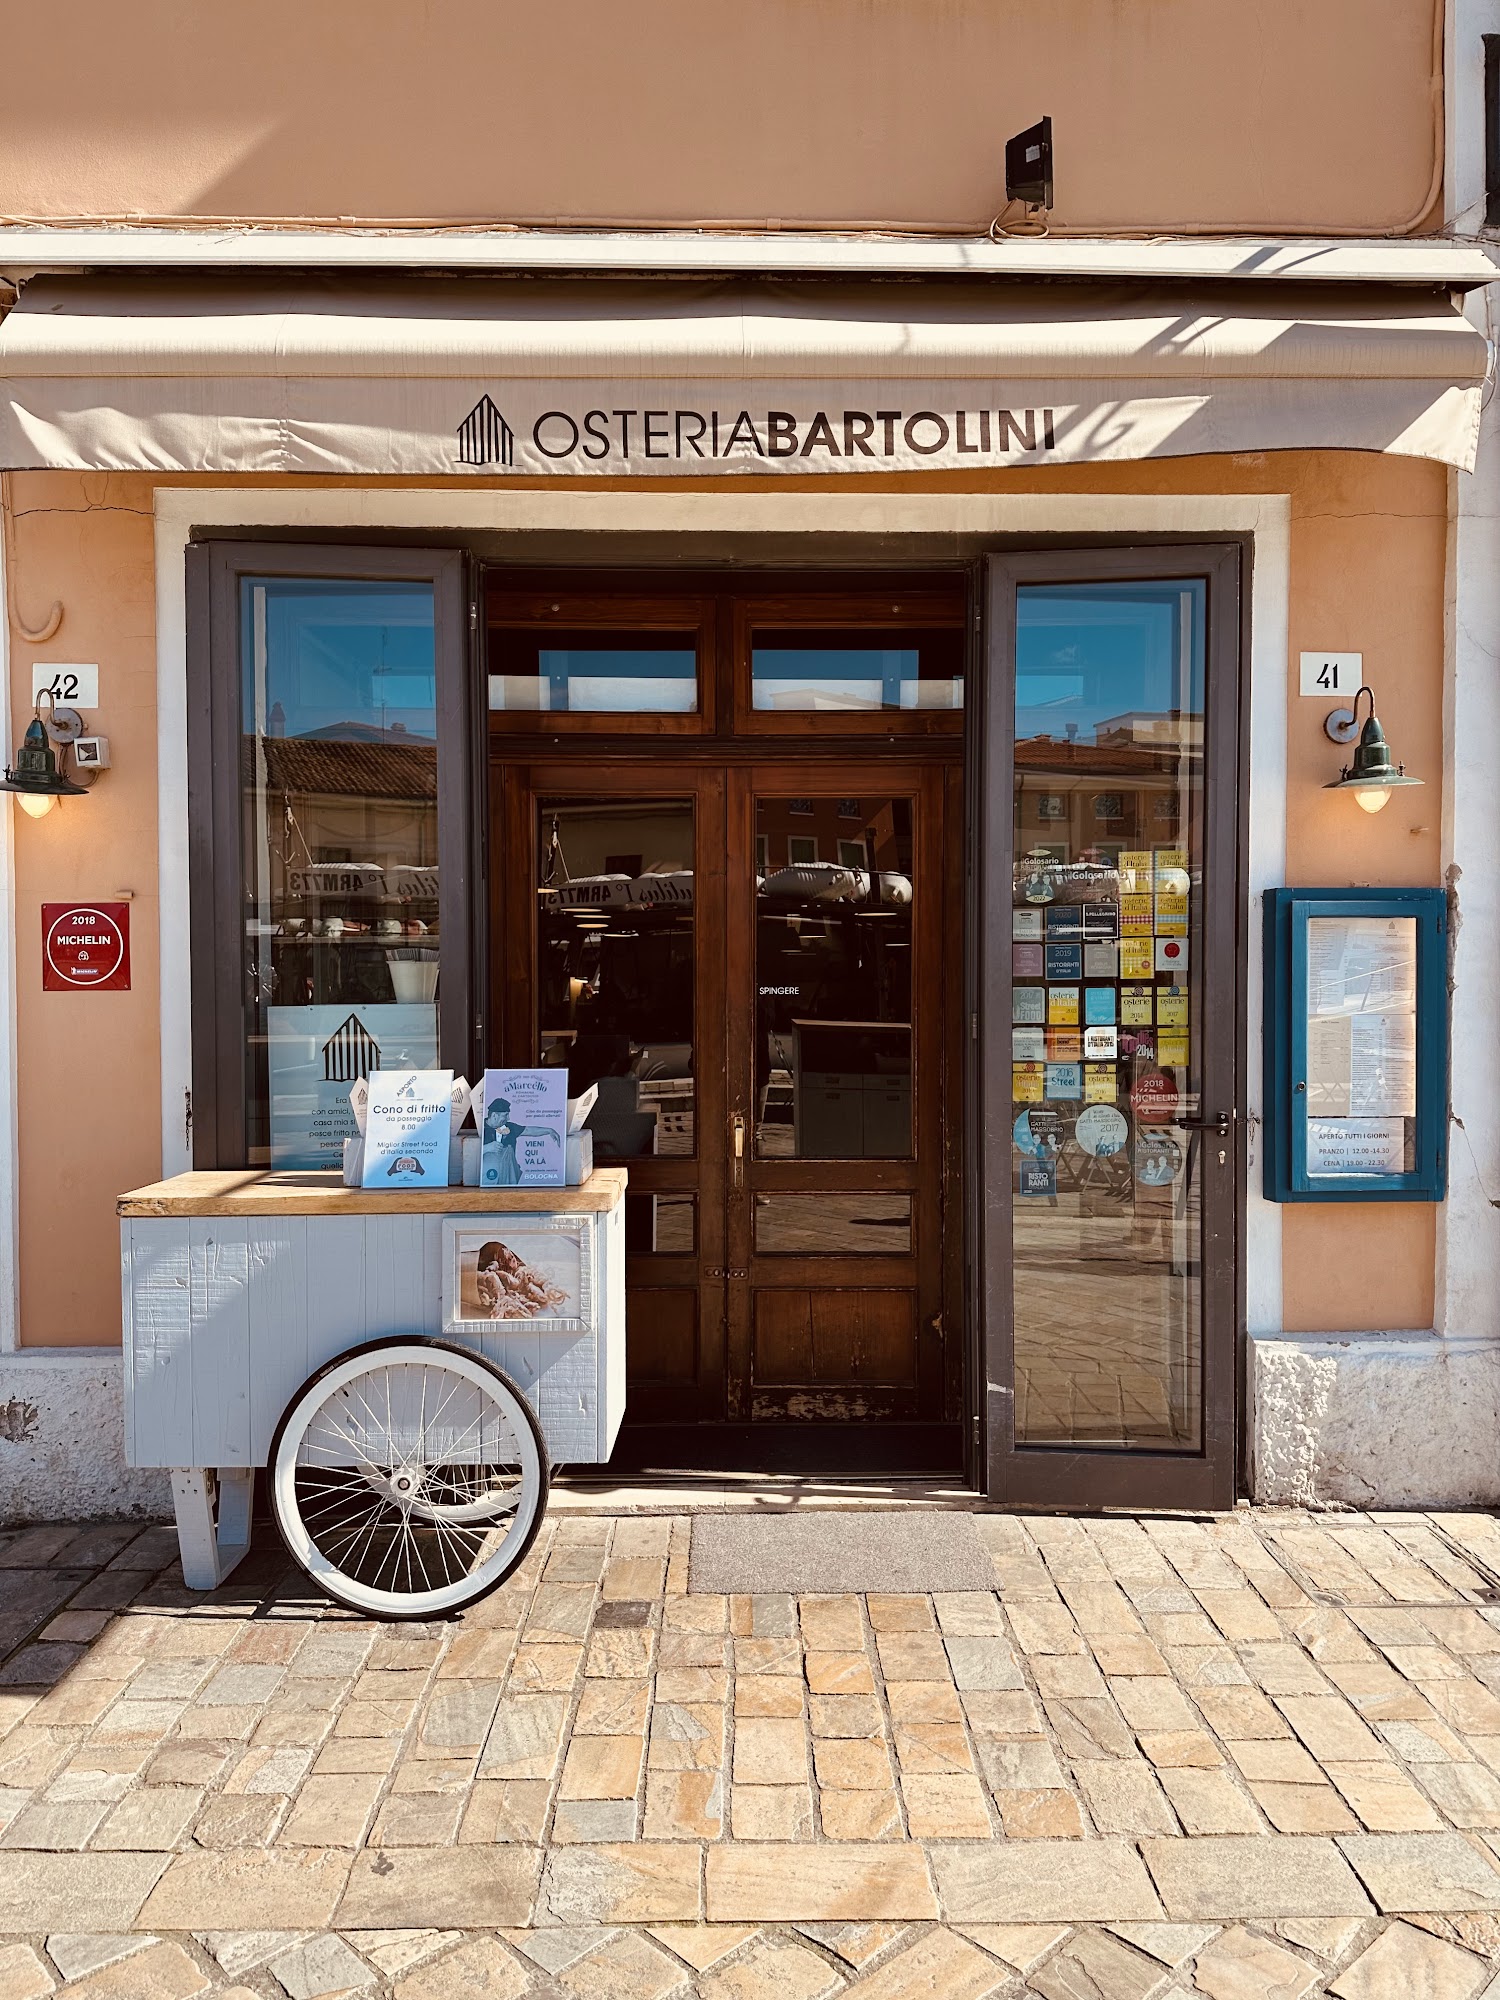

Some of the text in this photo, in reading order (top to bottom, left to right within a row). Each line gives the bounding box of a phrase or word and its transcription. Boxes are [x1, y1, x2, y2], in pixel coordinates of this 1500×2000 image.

[1316, 663, 1339, 689] 41
[49, 674, 79, 700] 42
[71, 915, 96, 925] 2018
[57, 935, 111, 945] MICHELIN
[1054, 949, 1072, 957] 2019
[759, 986, 800, 995] SPINGERE
[1020, 1001, 1041, 1011] Street
[1123, 998, 1150, 1006] osterie
[1020, 1010, 1041, 1021] FOOD
[1055, 1067, 1074, 1077] 2016
[1051, 1077, 1076, 1086] Street
[1088, 1076, 1113, 1084] osterie
[1143, 1079, 1165, 1088] 2018
[396, 1075, 418, 1097] ASPORTO
[1130, 1093, 1178, 1102] MICHELIN
[373, 1105, 403, 1114] Cono
[406, 1104, 417, 1113] di
[421, 1104, 446, 1113] fritto
[396, 1115, 432, 1123] passeggio
[1100, 1123, 1120, 1132] 2017
[377, 1141, 400, 1149] Miglior
[524, 1149, 539, 1157] QUI
[536, 1157, 547, 1165] LÀ
[1028, 1172, 1049, 1180] RISTO
[1028, 1179, 1049, 1187] RANTI
